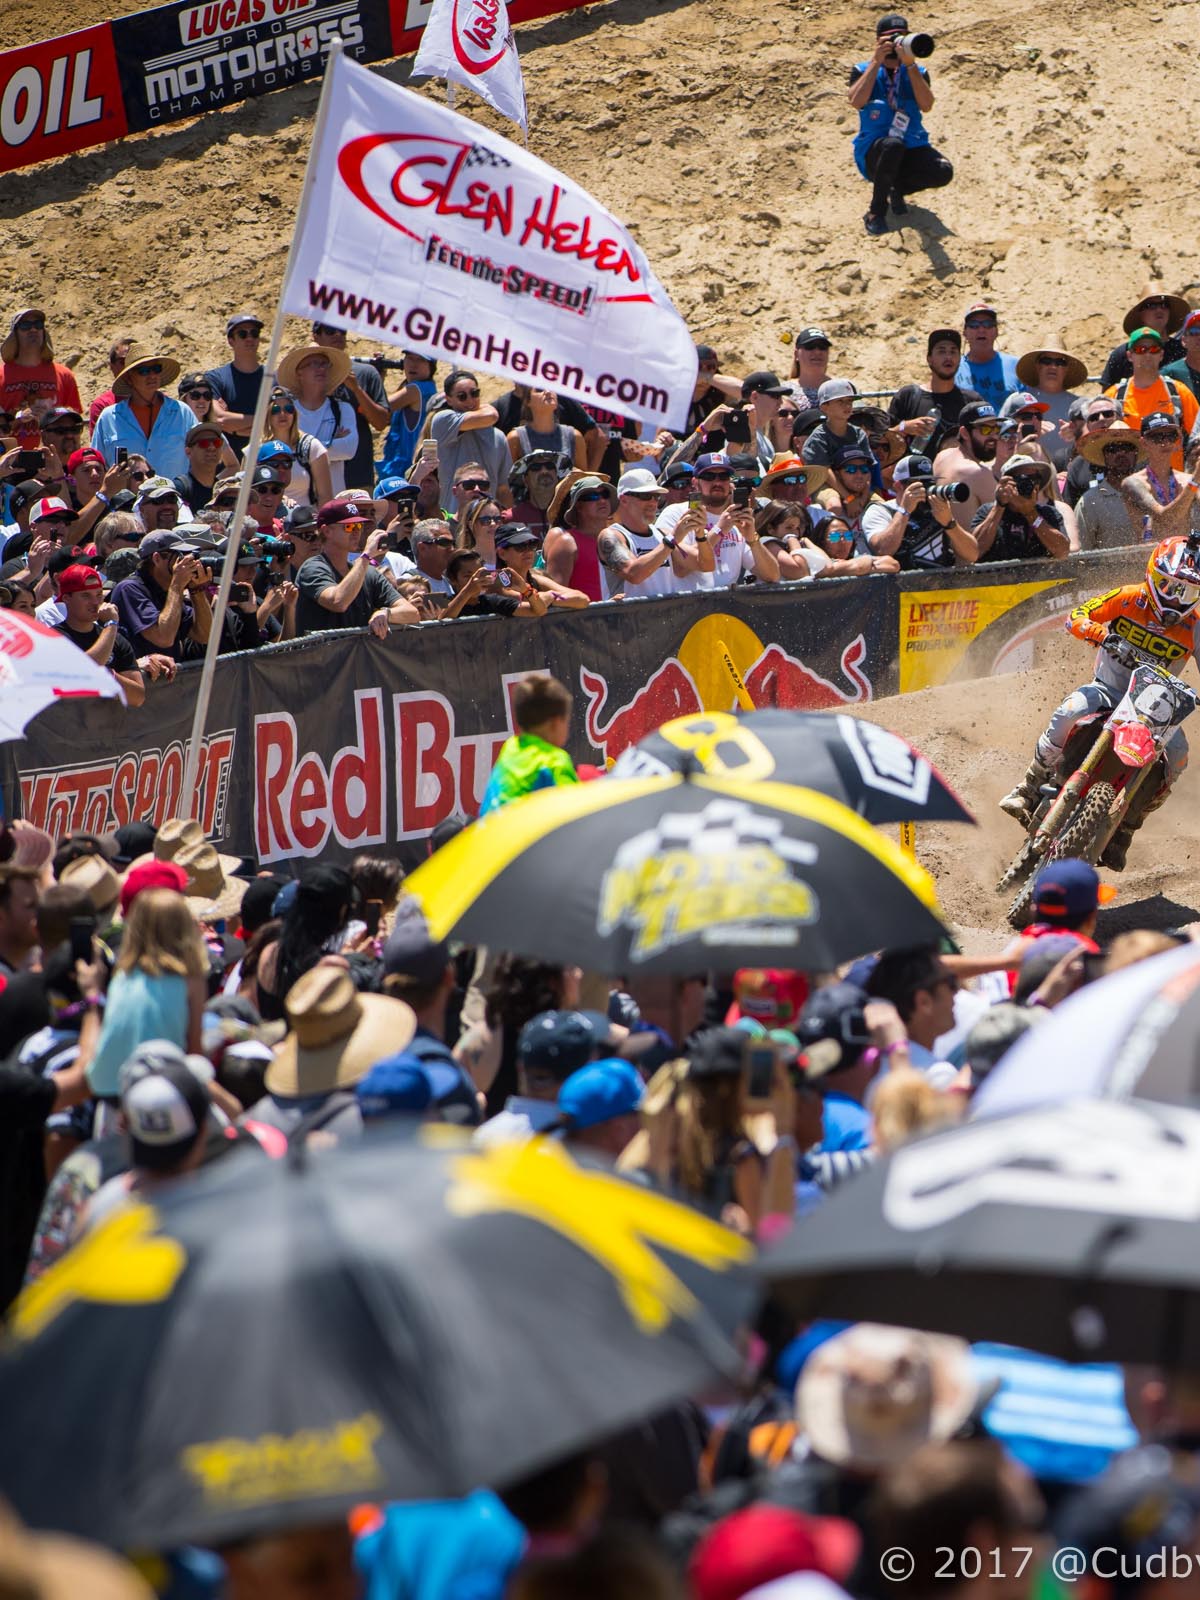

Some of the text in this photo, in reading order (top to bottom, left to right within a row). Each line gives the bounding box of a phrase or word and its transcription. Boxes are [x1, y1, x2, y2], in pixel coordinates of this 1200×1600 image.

[144, 13, 364, 106] MOTOCROSS
[223, 21, 283, 49] PRO
[0, 48, 103, 147] OIL
[149, 46, 366, 119] CHAMPIONSHP
[391, 145, 515, 237] GLEN
[308, 279, 671, 414] www.GlenHelen.com
[909, 599, 980, 624] LIFETIME
[1115, 616, 1187, 661] GEICO
[254, 687, 387, 864] Red
